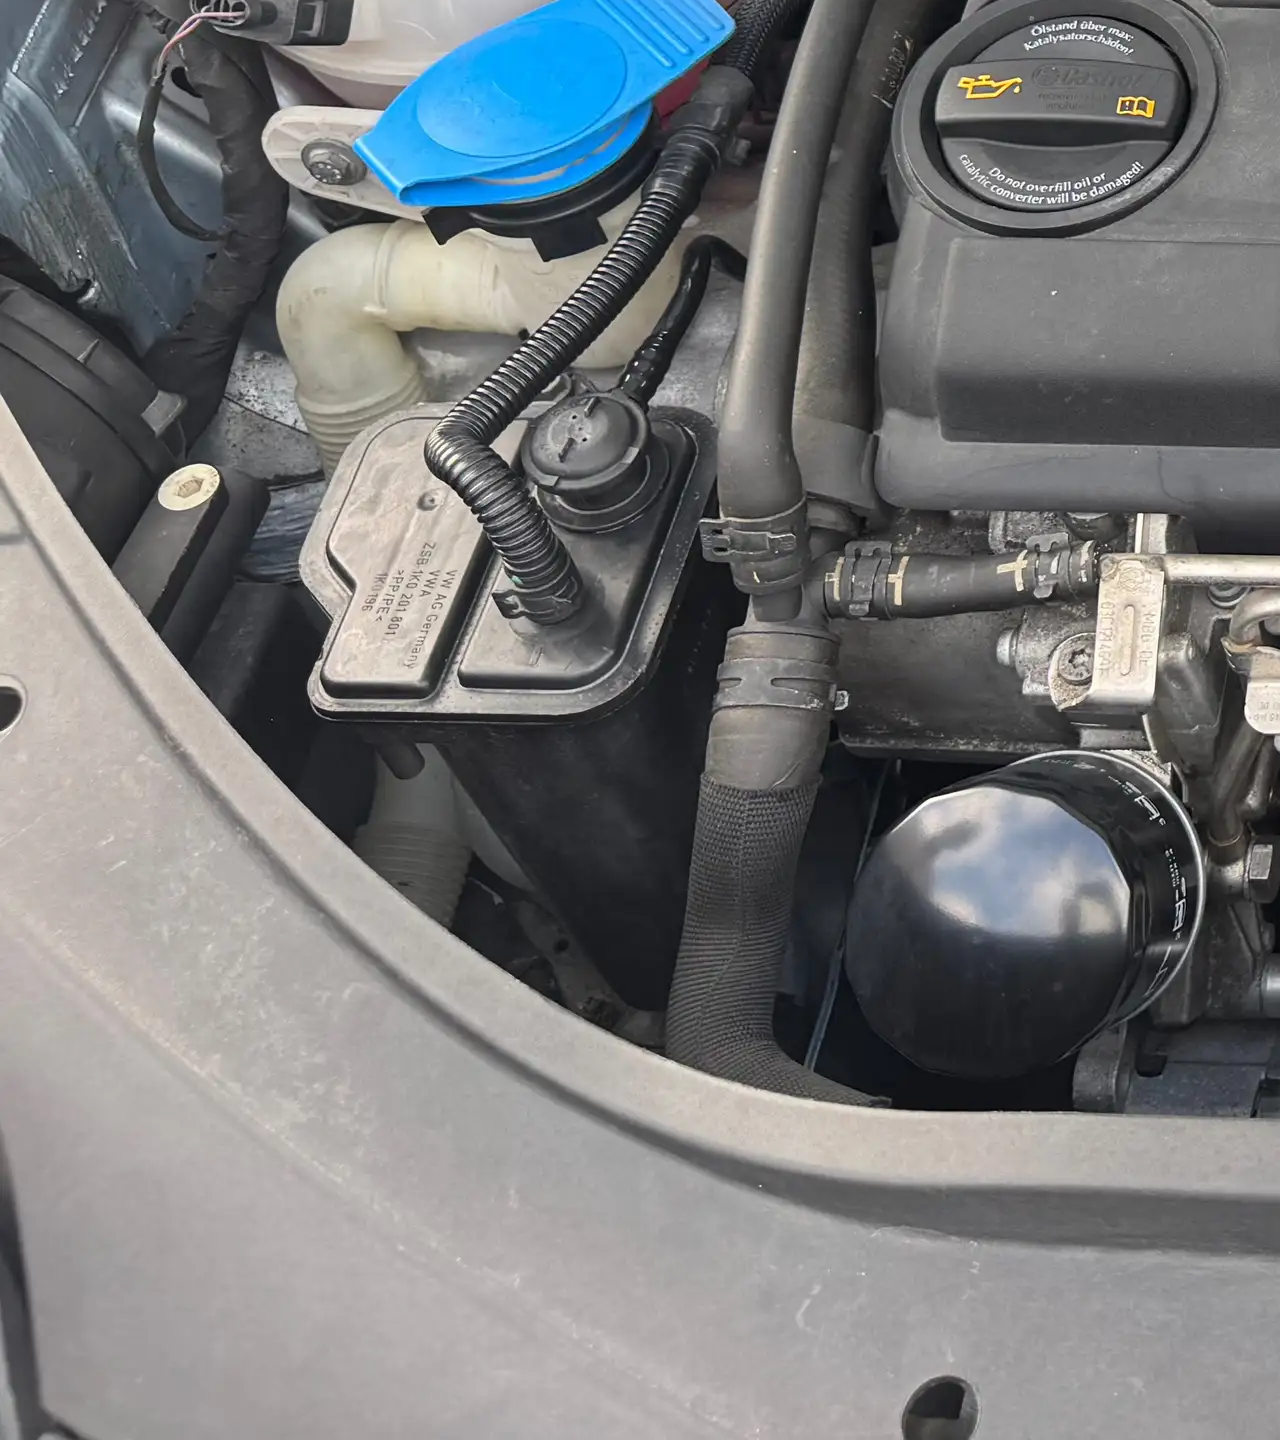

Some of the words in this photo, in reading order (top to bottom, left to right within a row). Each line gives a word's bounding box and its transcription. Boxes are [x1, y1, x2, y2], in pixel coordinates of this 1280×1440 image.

[1030, 20, 1078, 37] Ölstand
[1079, 20, 1107, 32] über
[1023, 32, 1135, 56] Katalysatorschäden!
[959, 153, 991, 190] catalytic
[990, 185, 1045, 205] converter
[1046, 194, 1070, 205] will
[1071, 191, 1088, 203] be
[1089, 160, 1146, 198] damaged!
[988, 167, 1006, 182] Do
[1004, 174, 1025, 190] not
[1026, 182, 1072, 193] overfill
[1073, 177, 1091, 190] oil
[1092, 171, 1107, 184] or
[419, 569, 441, 597] VWA
[440, 569, 458, 589] VW
[395, 592, 415, 613] 201
[431, 592, 447, 610] AG
[403, 613, 439, 670] Germany
